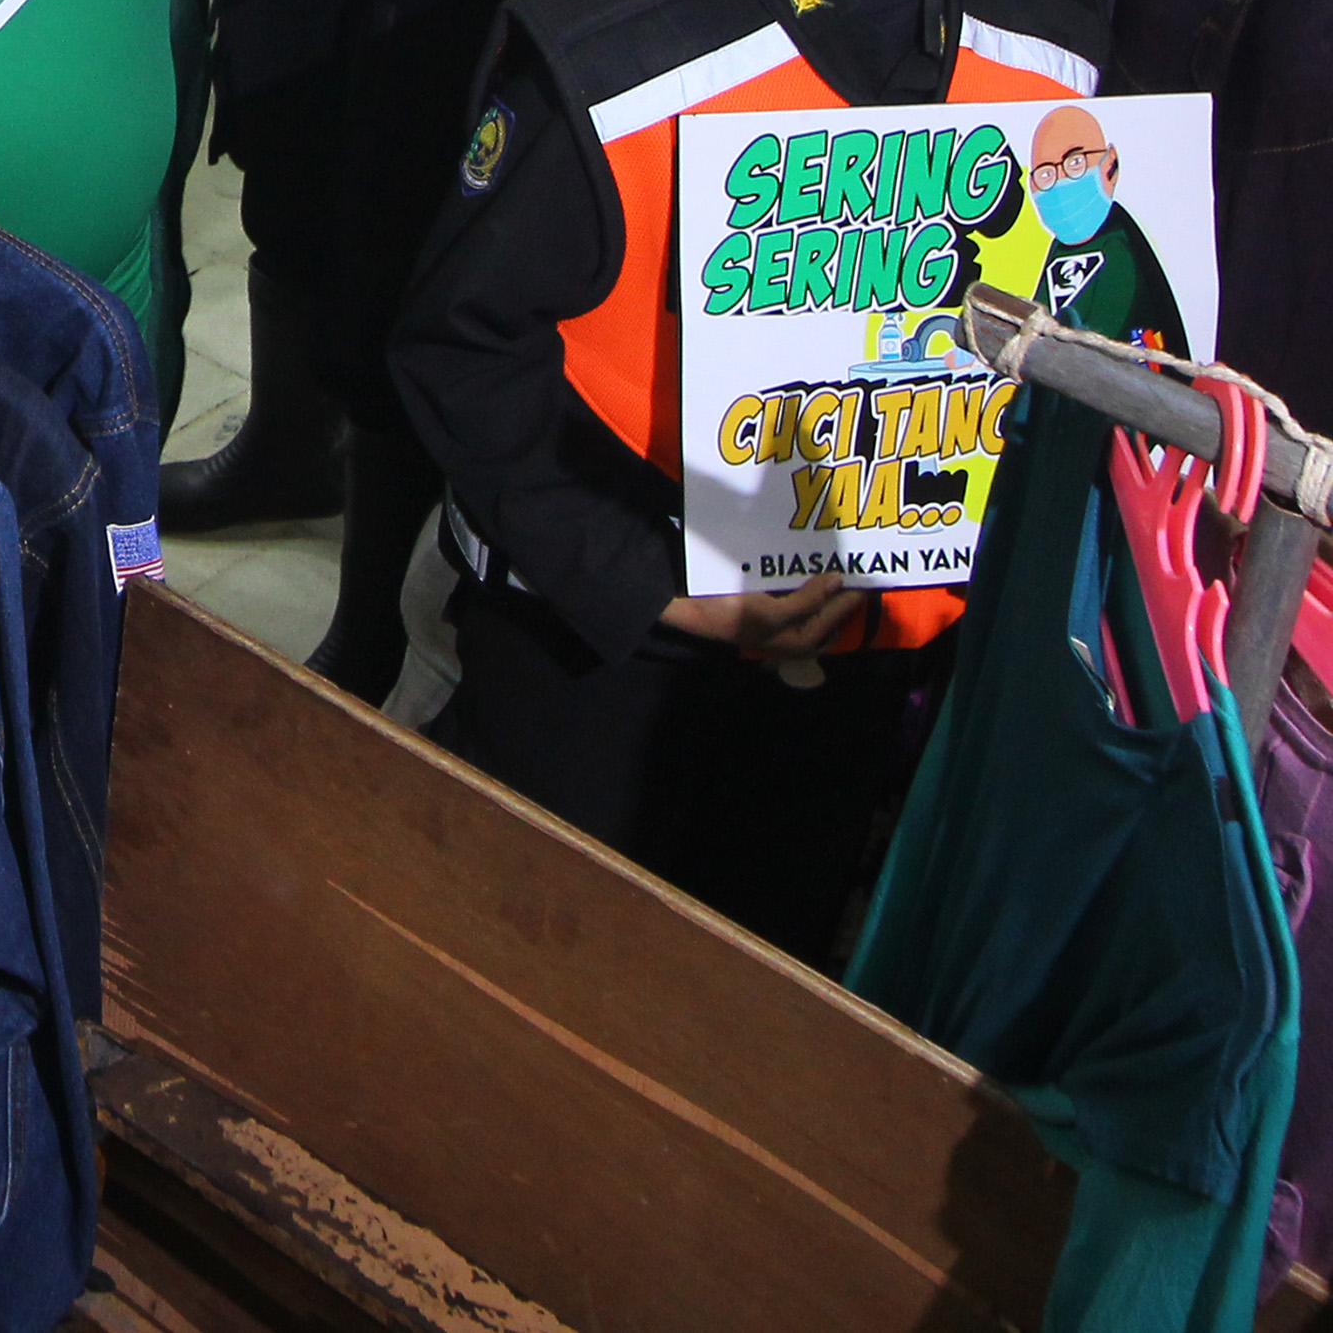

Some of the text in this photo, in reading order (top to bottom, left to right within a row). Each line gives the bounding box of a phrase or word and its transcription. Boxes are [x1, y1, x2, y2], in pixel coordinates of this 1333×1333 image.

[725, 125, 1011, 228] SERING
[702, 223, 955, 315] SERING
[718, 386, 861, 466] CUCI
[789, 458, 962, 531] YAA...
[760, 547, 971, 577] BIASAKAN YAN
